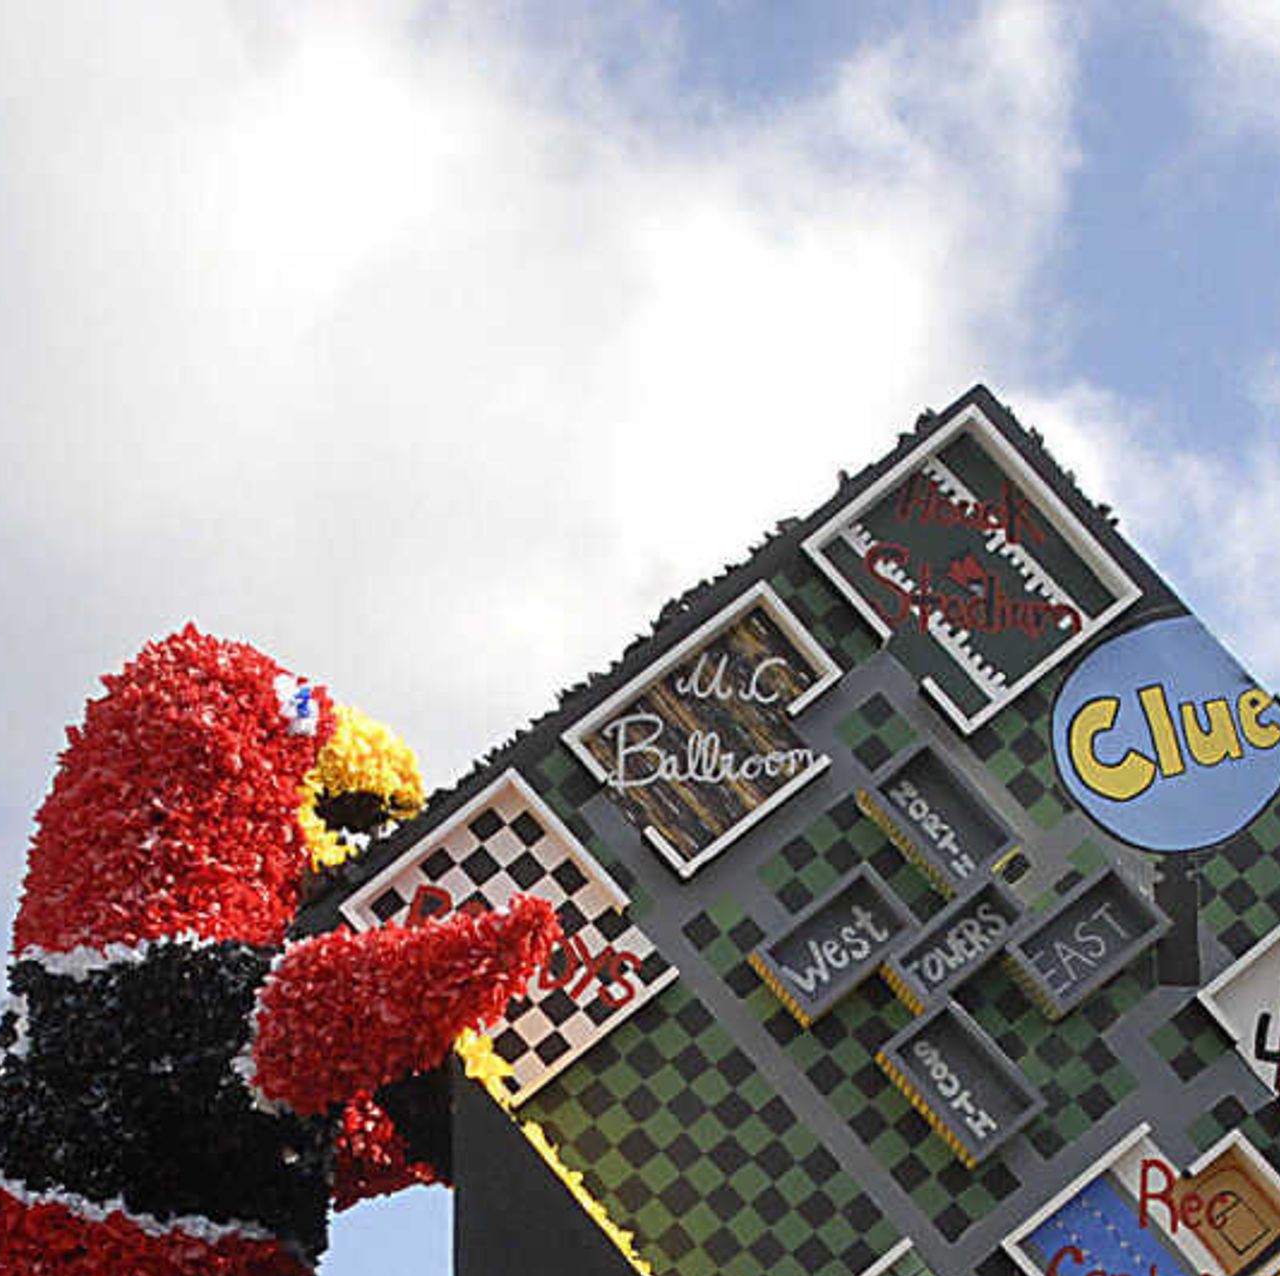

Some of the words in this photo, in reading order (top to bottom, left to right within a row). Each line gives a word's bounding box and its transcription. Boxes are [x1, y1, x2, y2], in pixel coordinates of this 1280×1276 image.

[603, 713, 814, 795] Ballroom
[1028, 902, 1127, 998] EAST
[913, 1041, 997, 1139] SOUTH
